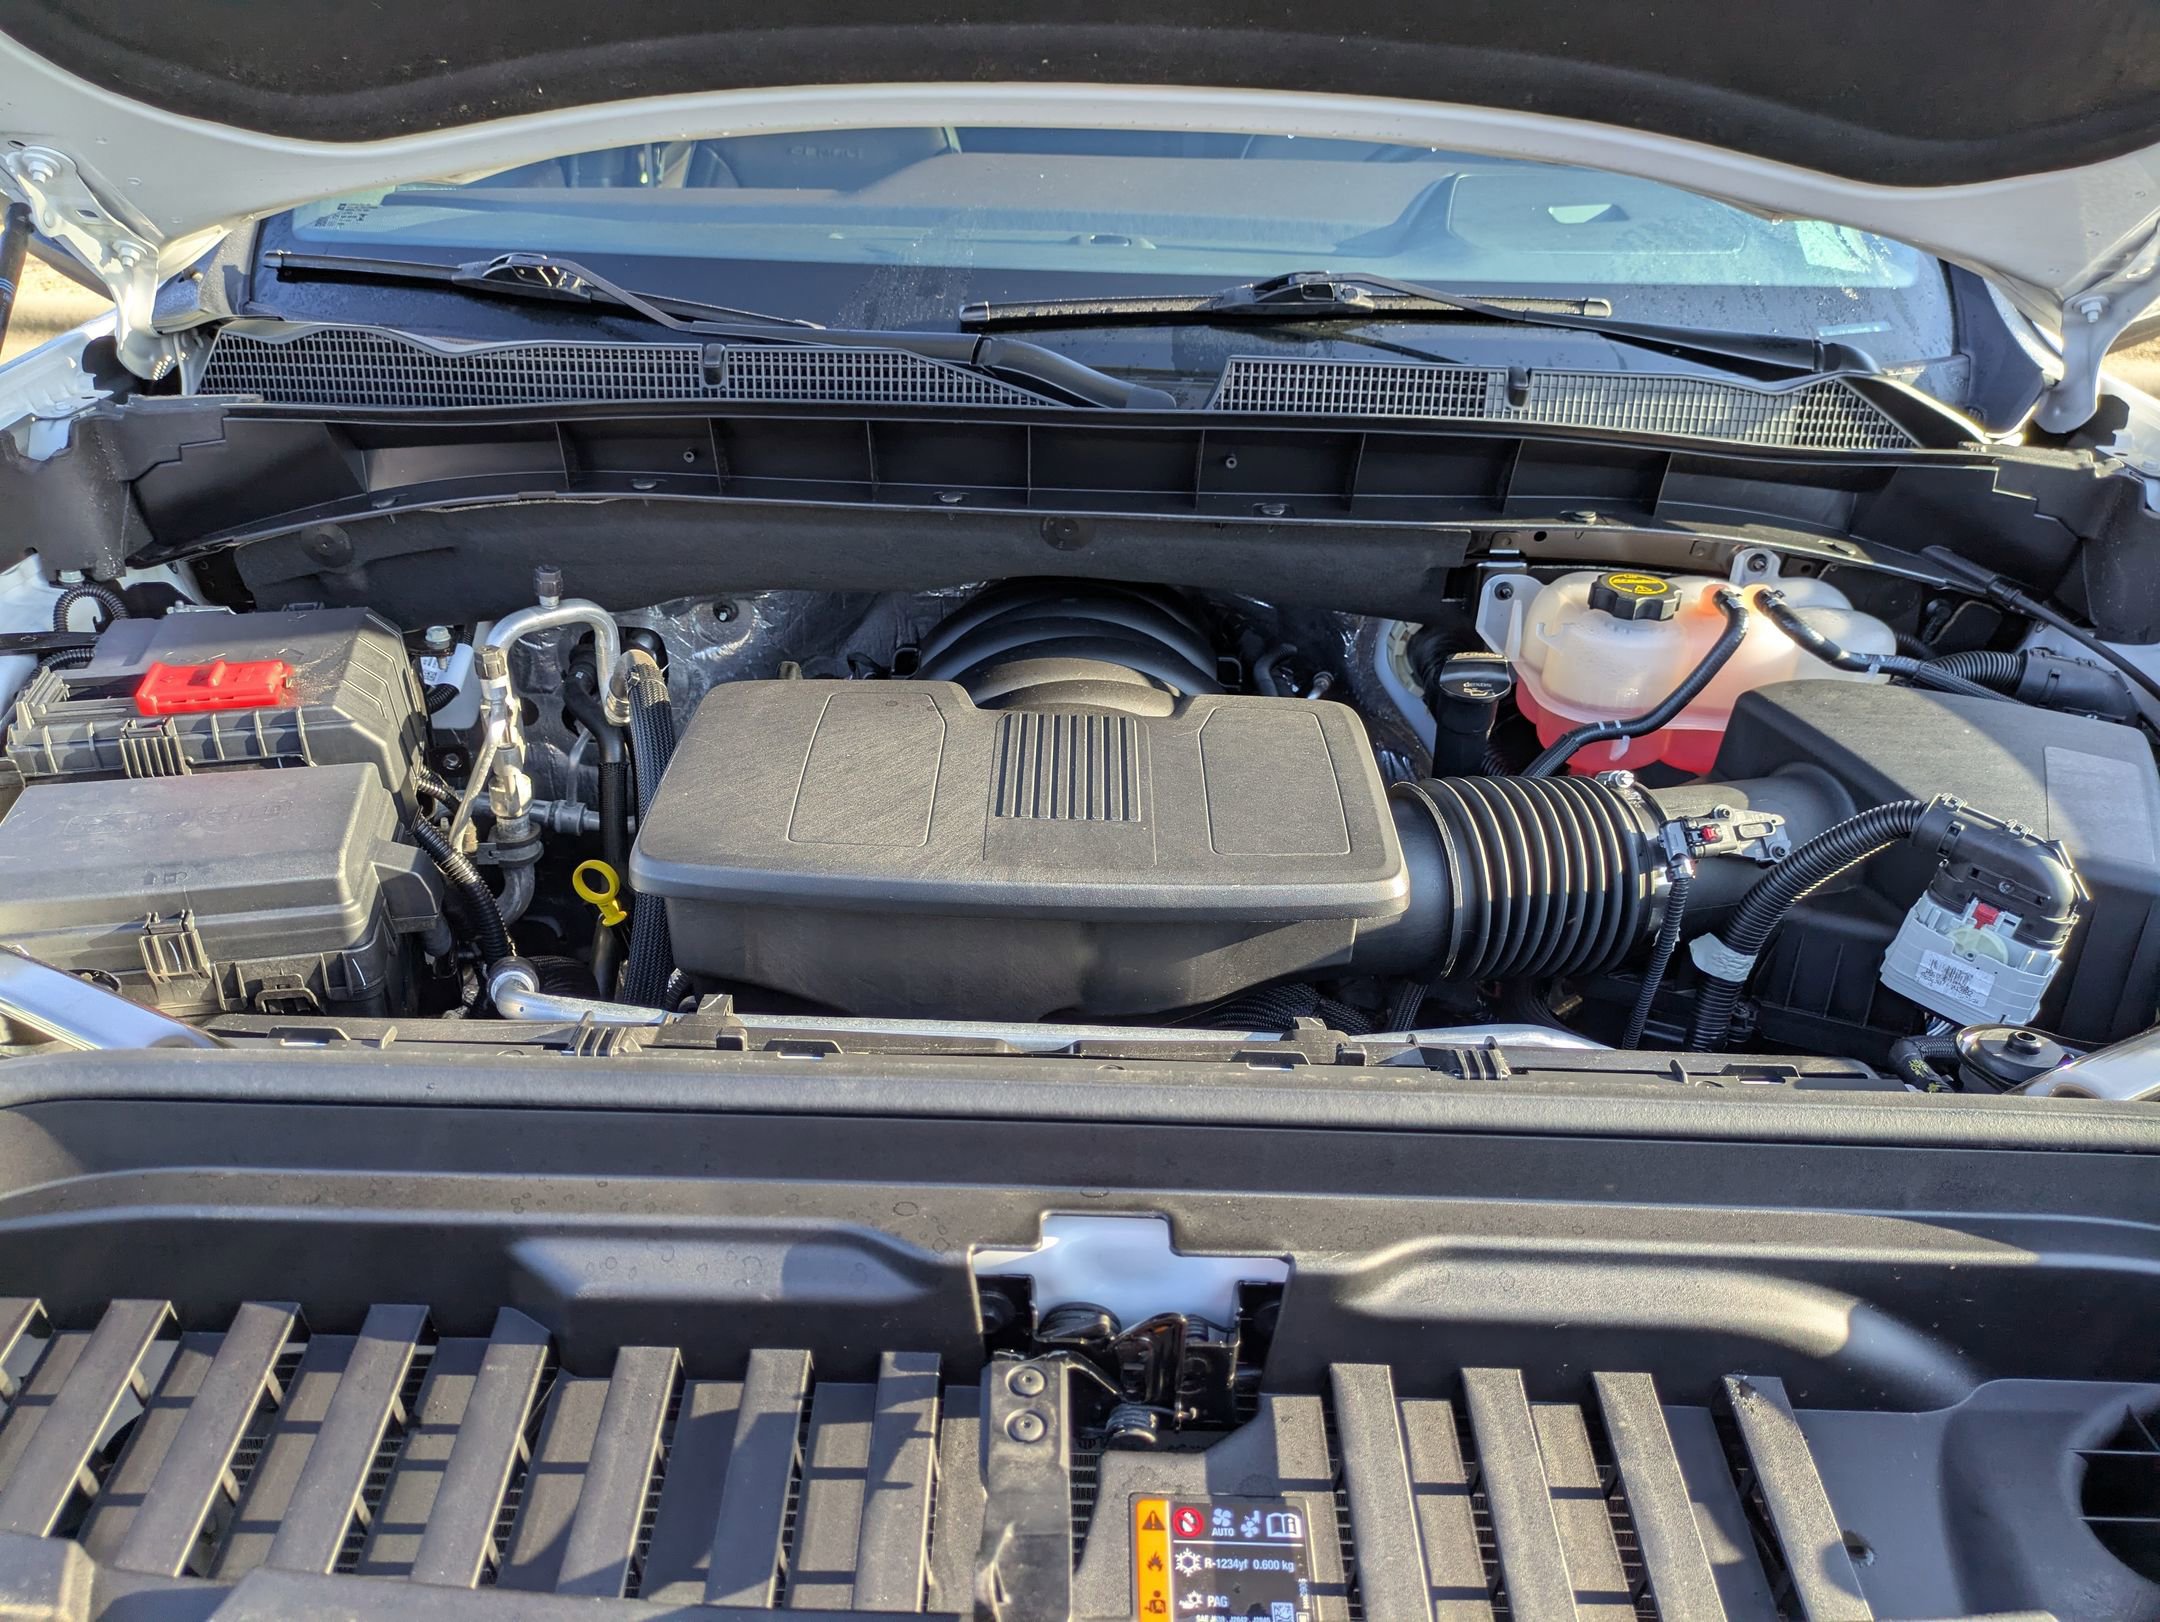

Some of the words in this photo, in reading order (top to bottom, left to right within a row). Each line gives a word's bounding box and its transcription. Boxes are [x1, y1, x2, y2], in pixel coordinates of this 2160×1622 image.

[1212, 1527, 1235, 1537] AUTO
[1204, 1558, 1249, 1572] R-1234yf
[1253, 1559, 1280, 1570] 0.600
[1282, 1560, 1295, 1573] kg
[1207, 1595, 1229, 1608] PAG
